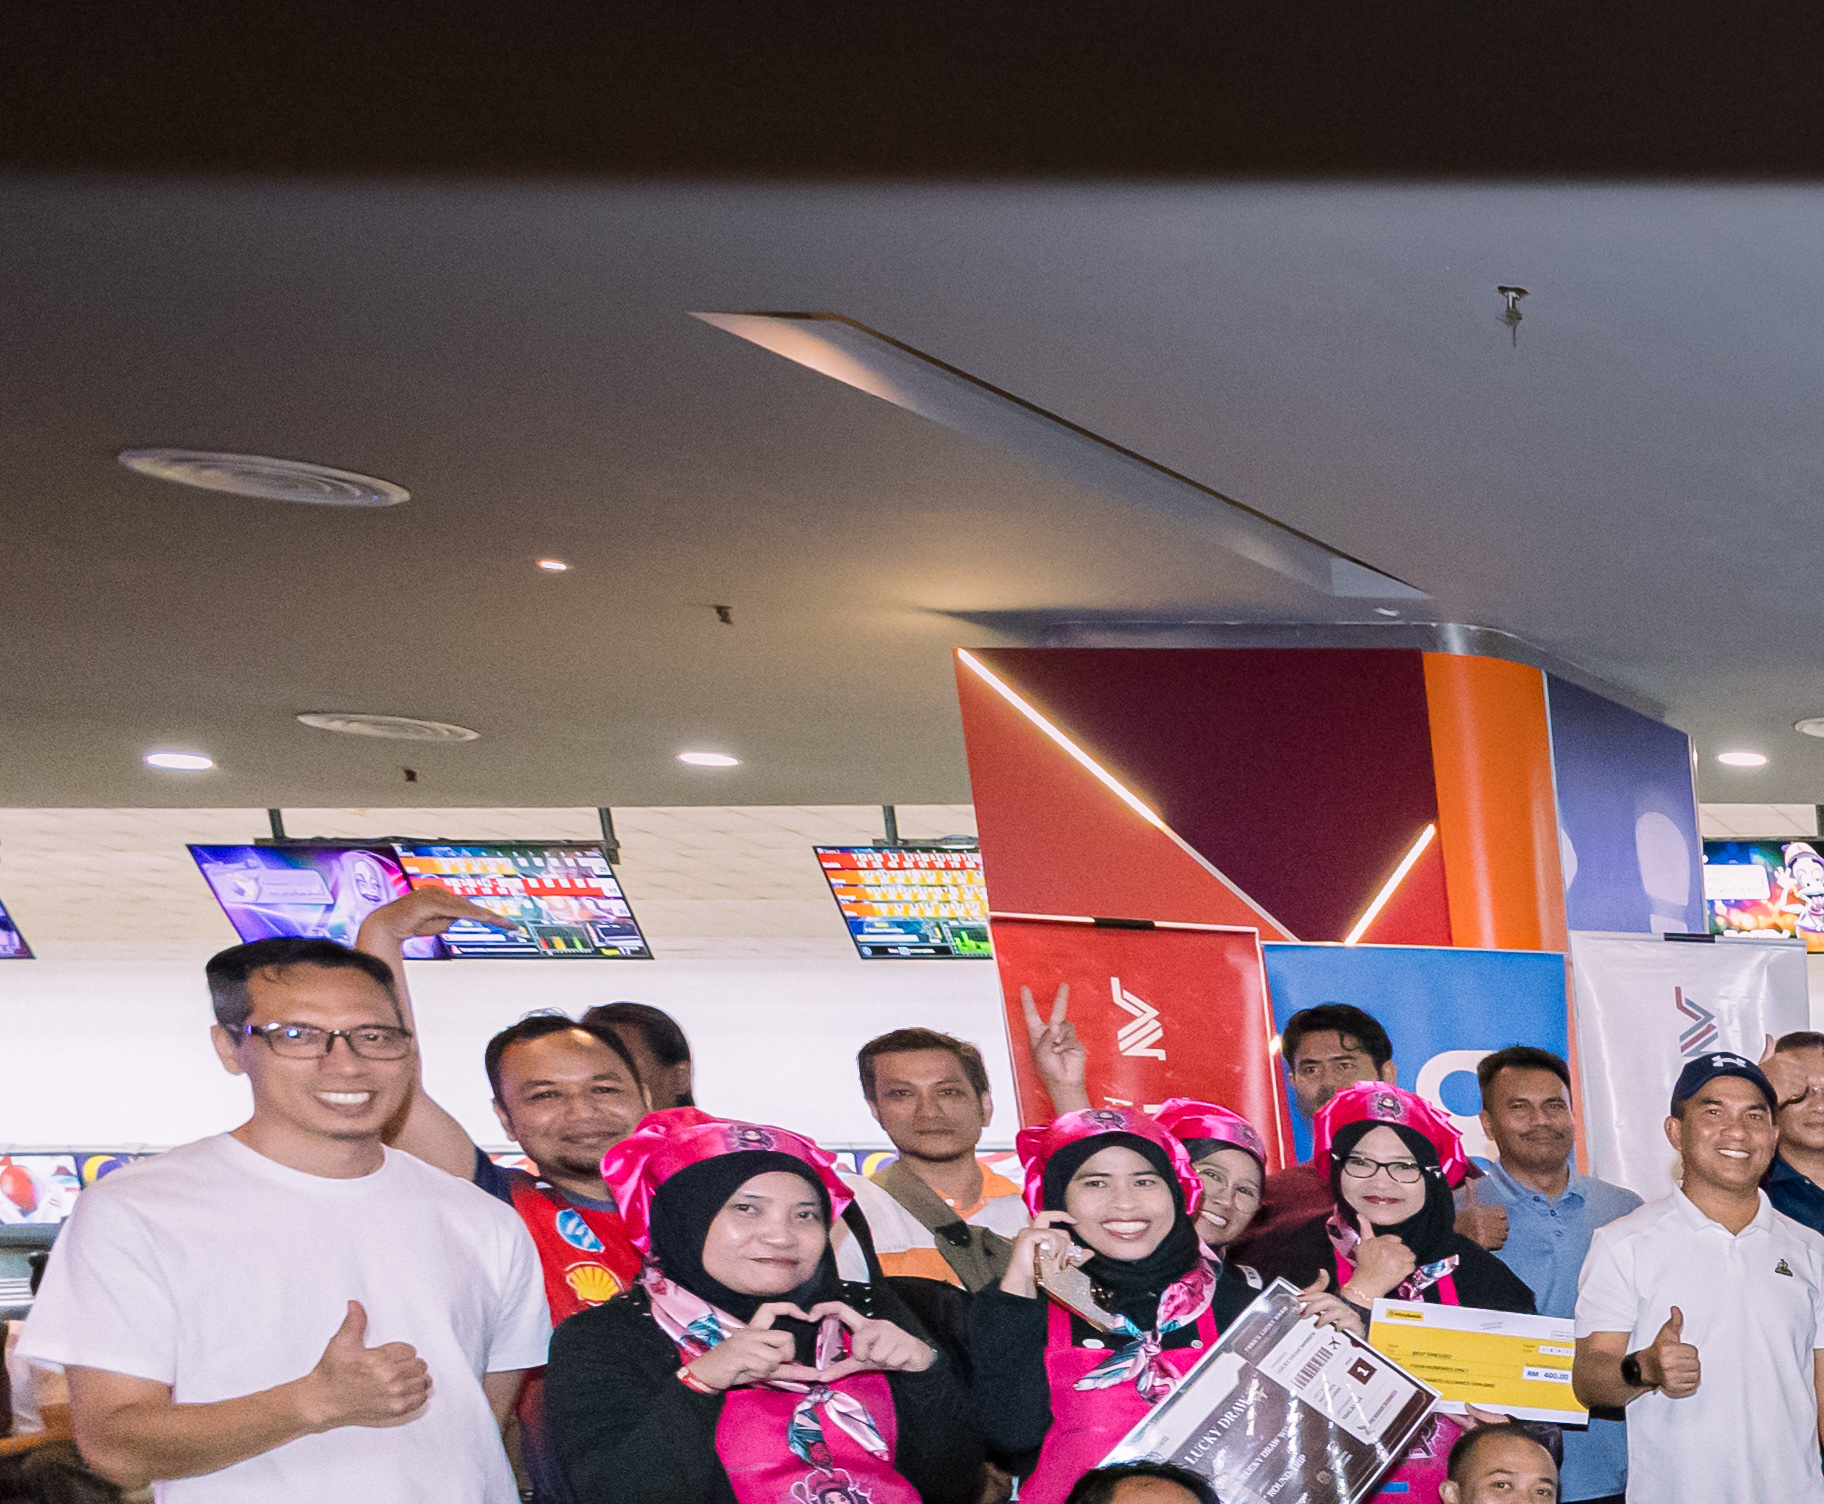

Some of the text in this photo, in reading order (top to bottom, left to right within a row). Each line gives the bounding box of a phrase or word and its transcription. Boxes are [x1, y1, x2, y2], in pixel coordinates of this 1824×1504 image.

[1356, 1366, 1370, 1377] 1
[1544, 1372, 1569, 1380] 400.00
[1183, 1431, 1223, 1465] LUCKY
